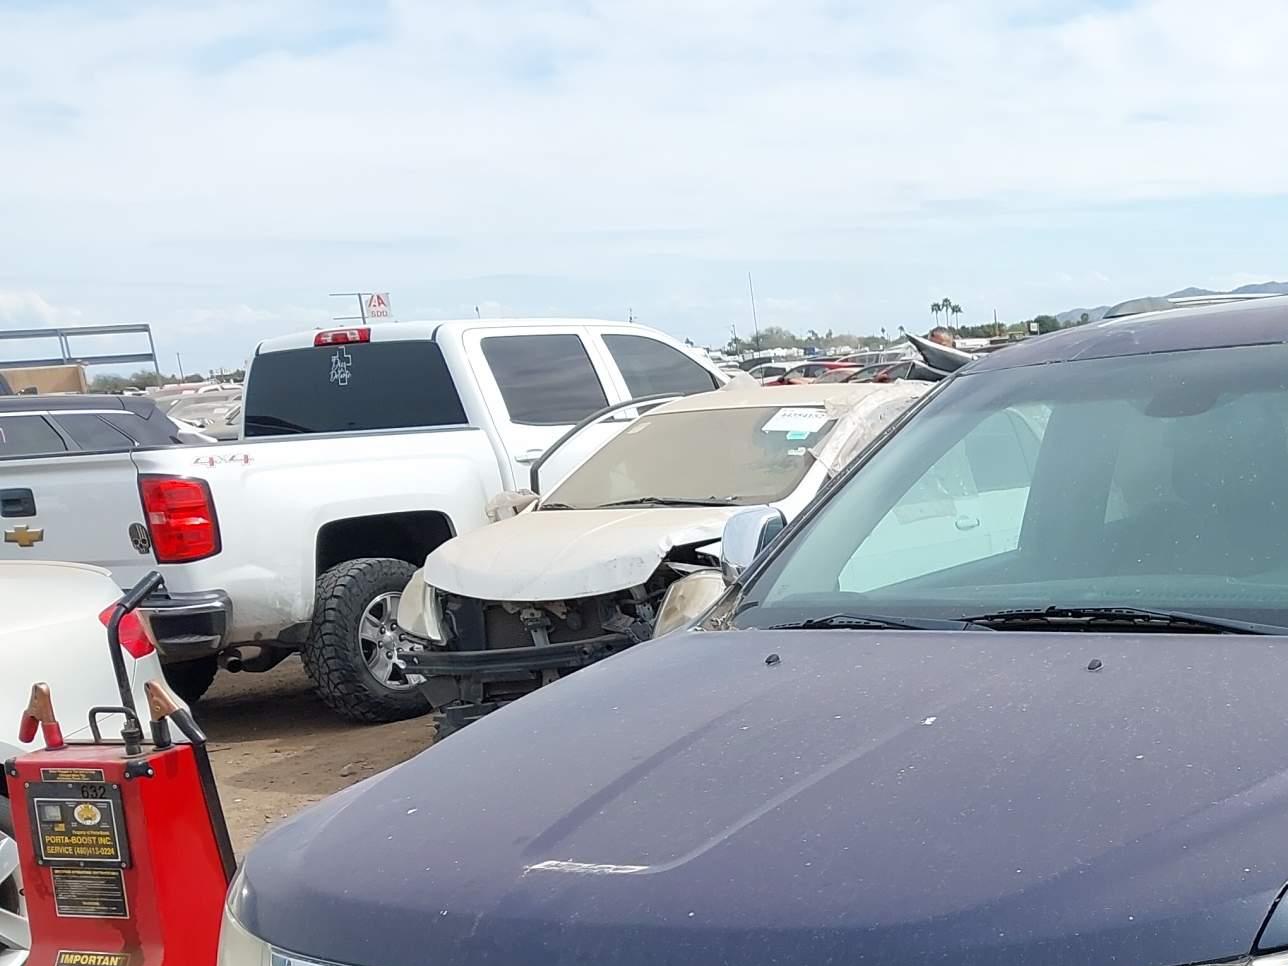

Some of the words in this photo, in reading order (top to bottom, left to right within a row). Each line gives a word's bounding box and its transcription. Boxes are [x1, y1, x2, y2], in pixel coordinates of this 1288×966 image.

[81, 785, 107, 799] 632
[45, 835, 97, 845] PORTA-BOOST
[98, 836, 113, 845] INC.
[46, 846, 73, 855] SERVICE
